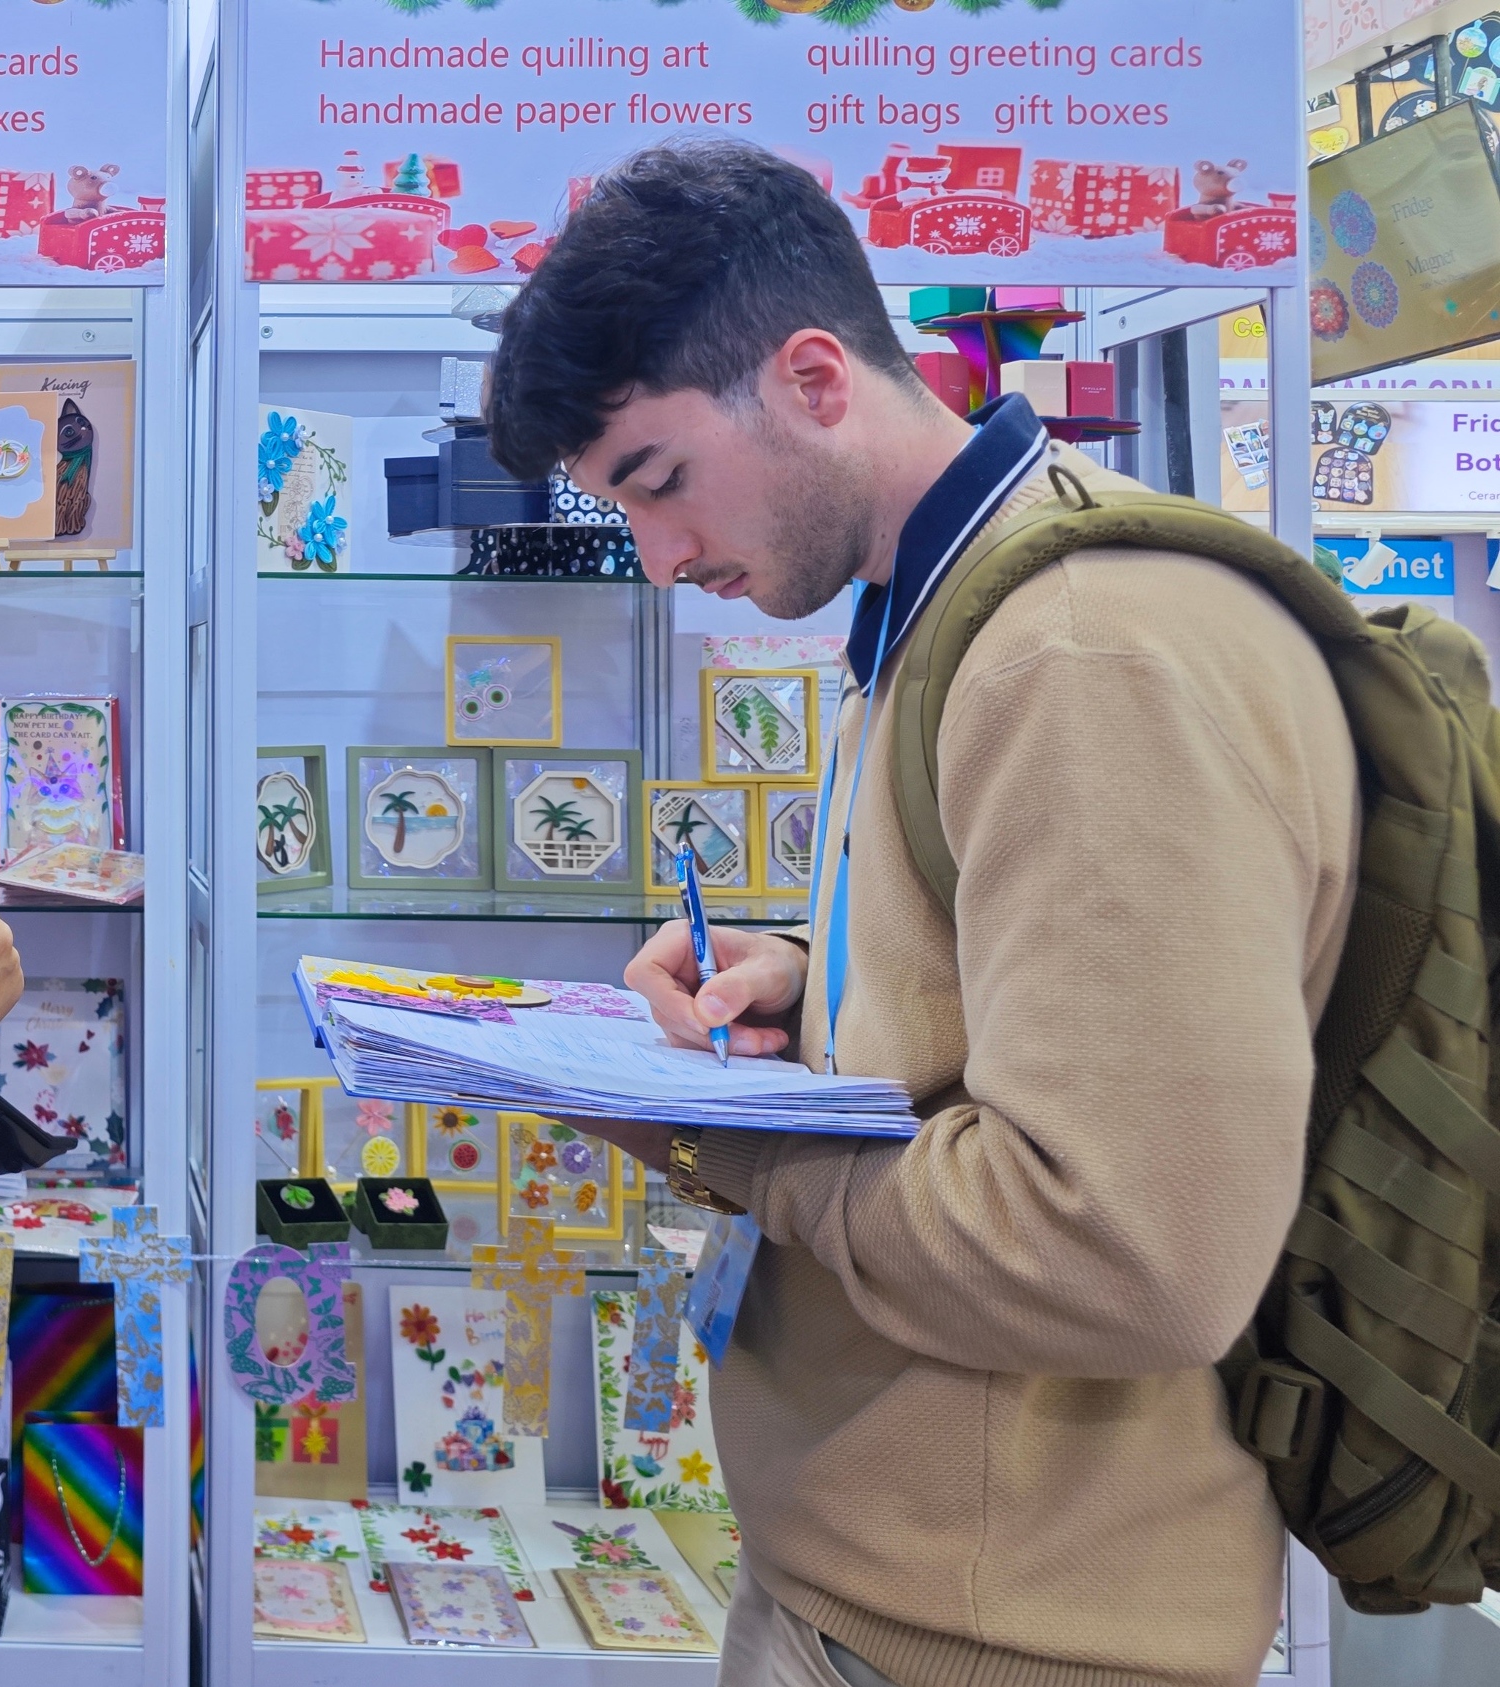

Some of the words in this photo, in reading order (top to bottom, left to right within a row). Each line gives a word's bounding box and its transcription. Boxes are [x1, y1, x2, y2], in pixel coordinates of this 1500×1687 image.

[321, 39, 509, 69] Handmade
[522, 38, 649, 77] quilling
[663, 43, 709, 68] art
[807, 37, 936, 75] quilling
[949, 37, 1097, 74] greeting
[1110, 38, 1202, 68] cards
[320, 95, 503, 124] handmade
[516, 102, 615, 132] paper
[628, 94, 752, 124] flowers
[807, 94, 864, 133] gift
[878, 95, 961, 133] bags
[994, 95, 1052, 133] gift
[1067, 96, 1170, 126] boxes
[1392, 196, 1434, 222] Fridge
[1406, 250, 1456, 276] Magnet
[1233, 317, 1265, 337] Ce
[40, 377, 92, 399] Kucing
[13, 712, 40, 720] HAPPY
